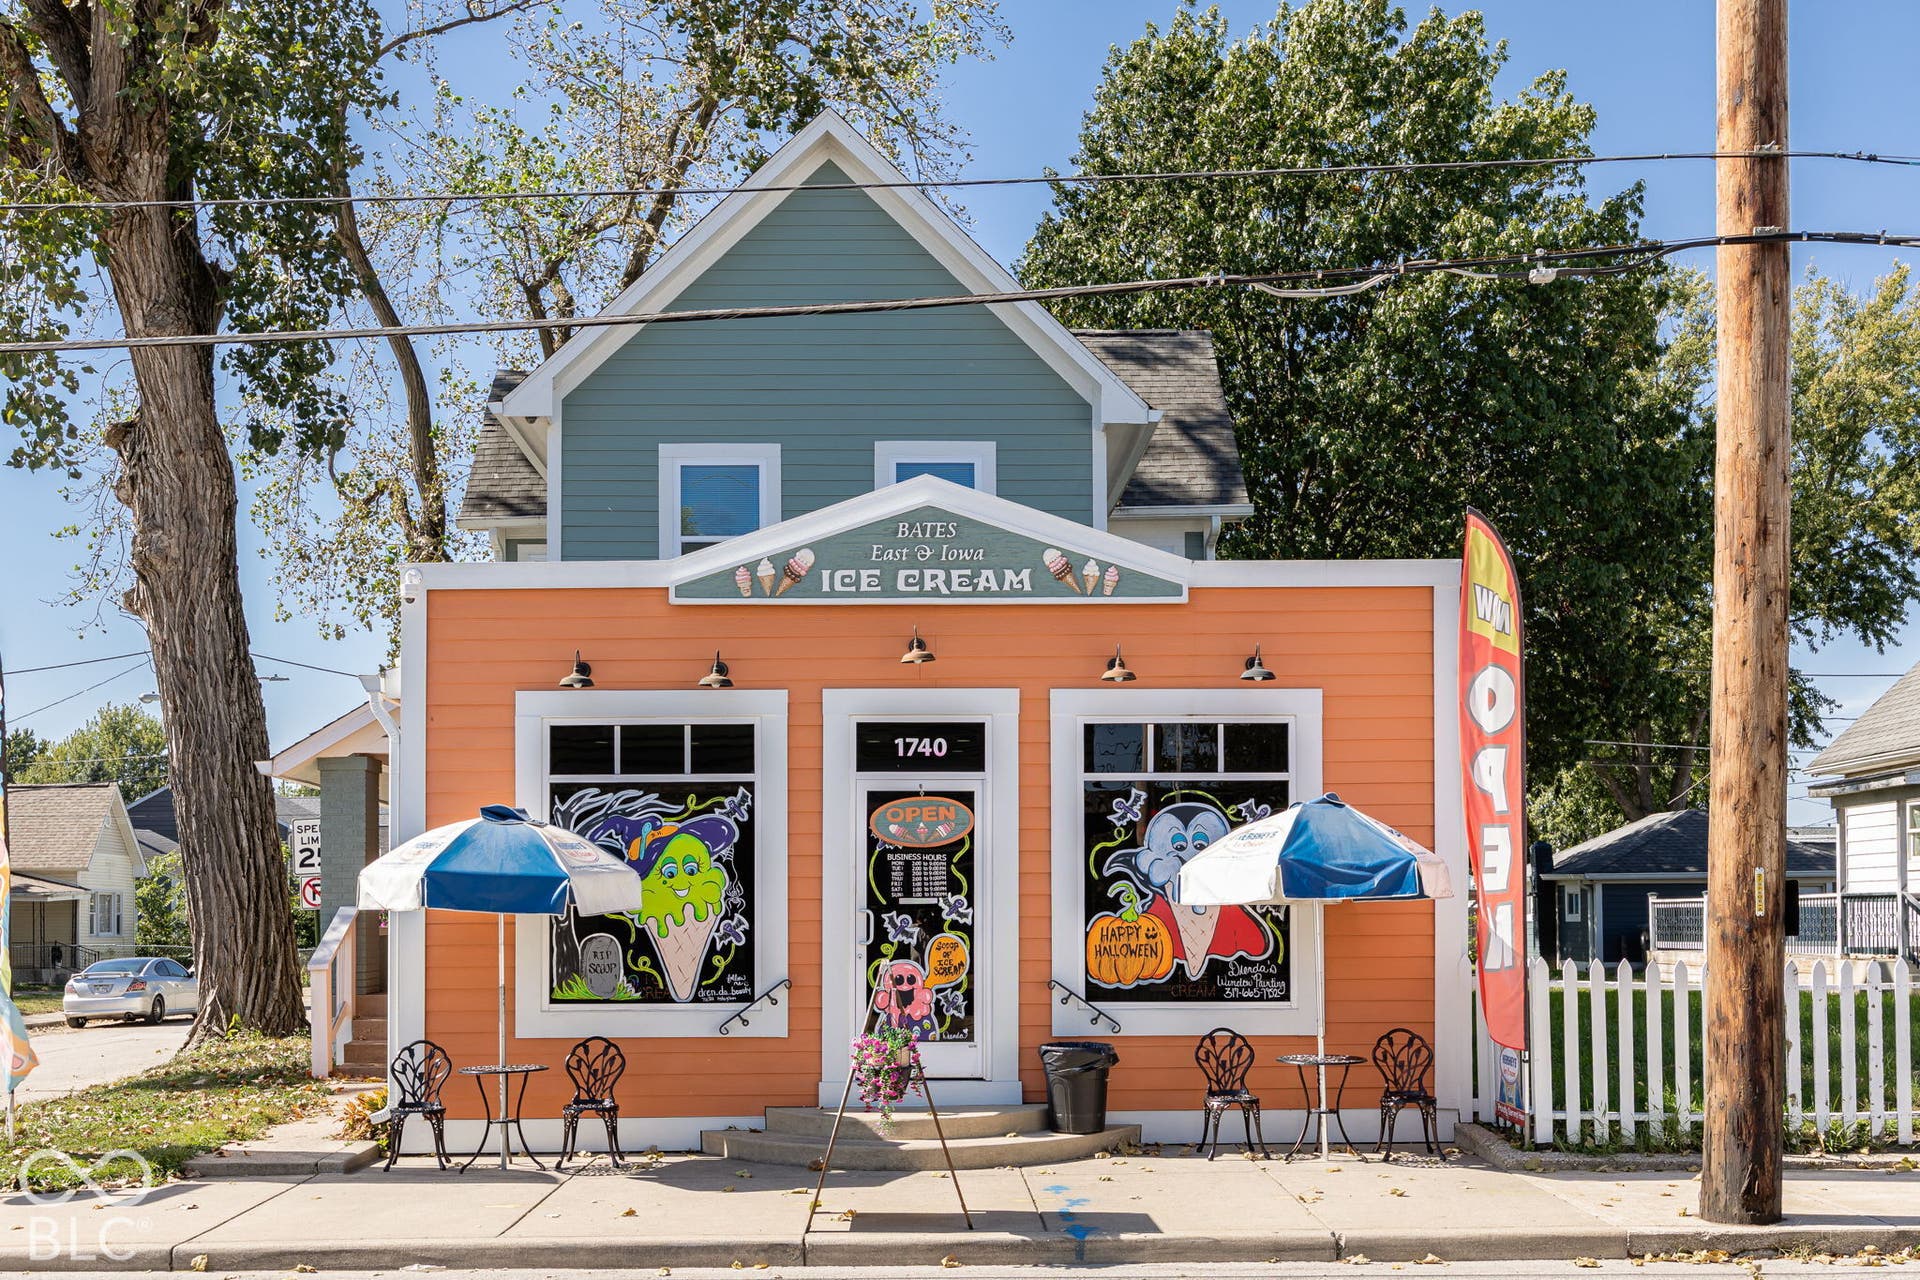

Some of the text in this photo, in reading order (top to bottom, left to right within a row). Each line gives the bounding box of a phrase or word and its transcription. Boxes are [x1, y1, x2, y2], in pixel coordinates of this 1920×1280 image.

[896, 522, 958, 538] BATES
[870, 544, 909, 561] East
[940, 544, 984, 561] Iowa
[821, 568, 1033, 595] ICE CREAM
[894, 738, 948, 757] 1740
[886, 807, 955, 822] OPEN
[297, 824, 320, 834] SPE
[301, 836, 320, 845] LIM
[1100, 925, 1140, 942] HAPPY
[936, 941, 959, 951] SCOOP
[1094, 941, 1159, 959] HALLOWEEN
[592, 951, 612, 960] RIP
[937, 959, 954, 967] ICE
[589, 963, 617, 974] SCOOP
[934, 960, 965, 977] SCREAM
